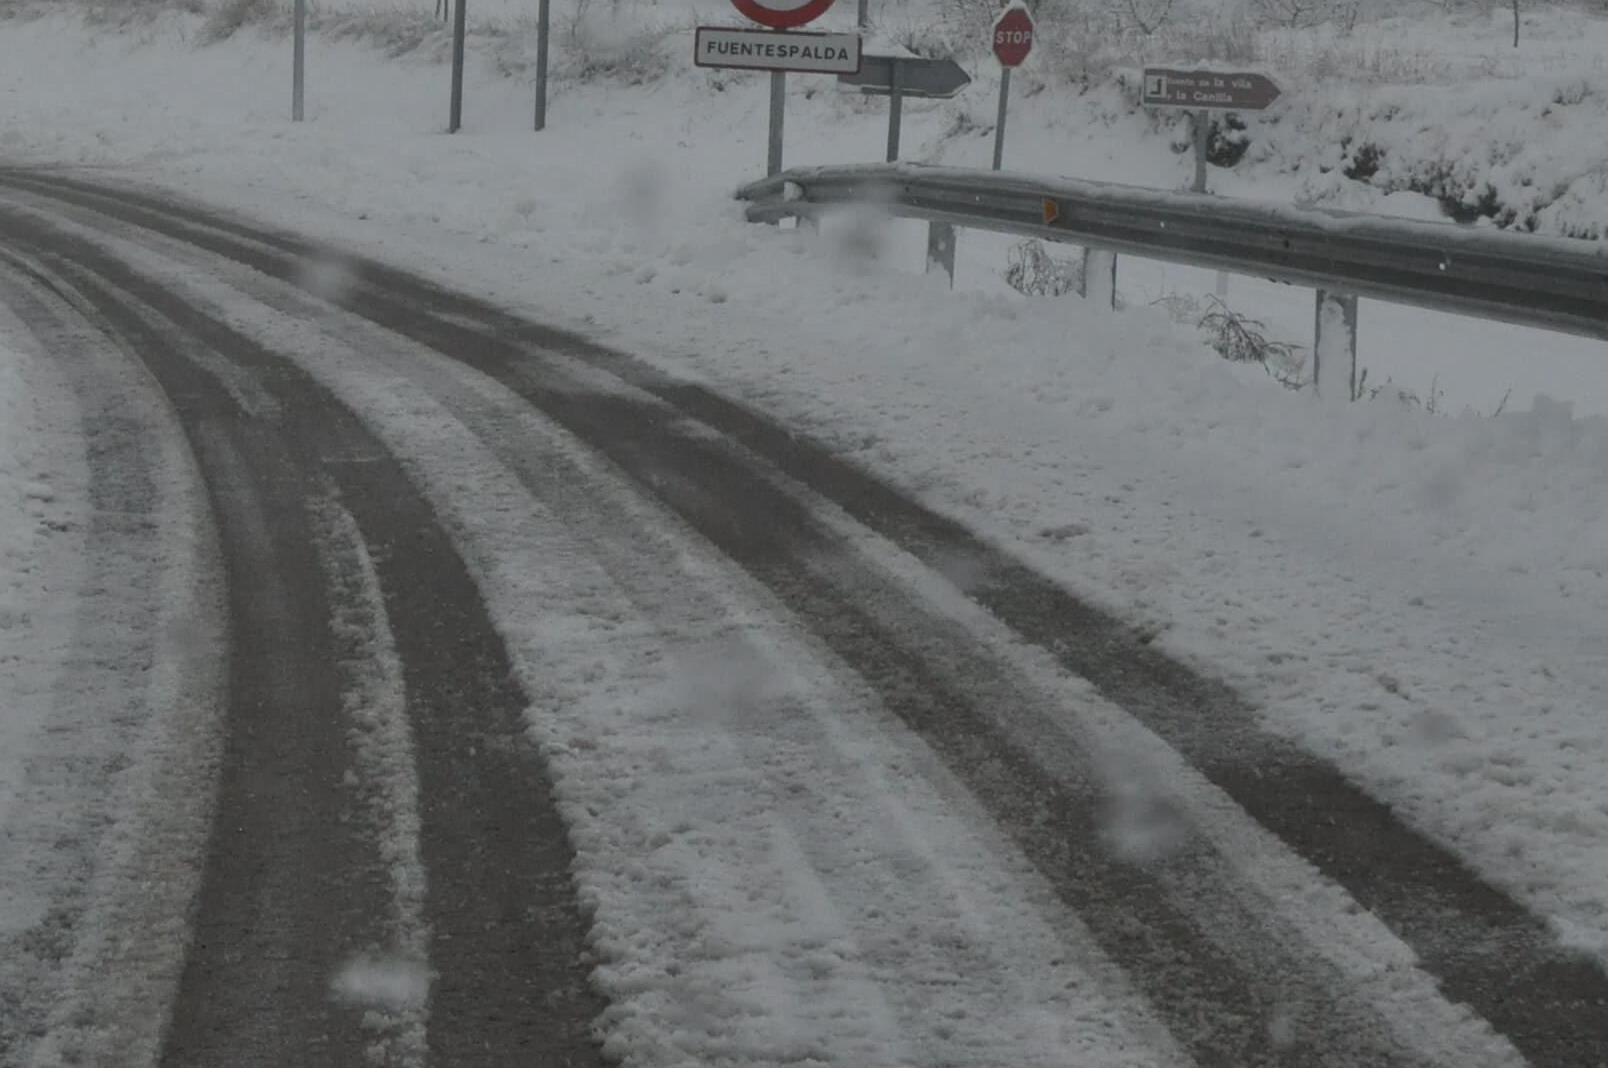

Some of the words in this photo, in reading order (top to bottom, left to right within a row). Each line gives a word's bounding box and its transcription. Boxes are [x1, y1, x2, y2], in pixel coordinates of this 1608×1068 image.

[996, 31, 1031, 44] STOP
[707, 41, 848, 60] FUENTESPALDA
[1176, 89, 1187, 100] la
[1193, 91, 1232, 103] Canilla
